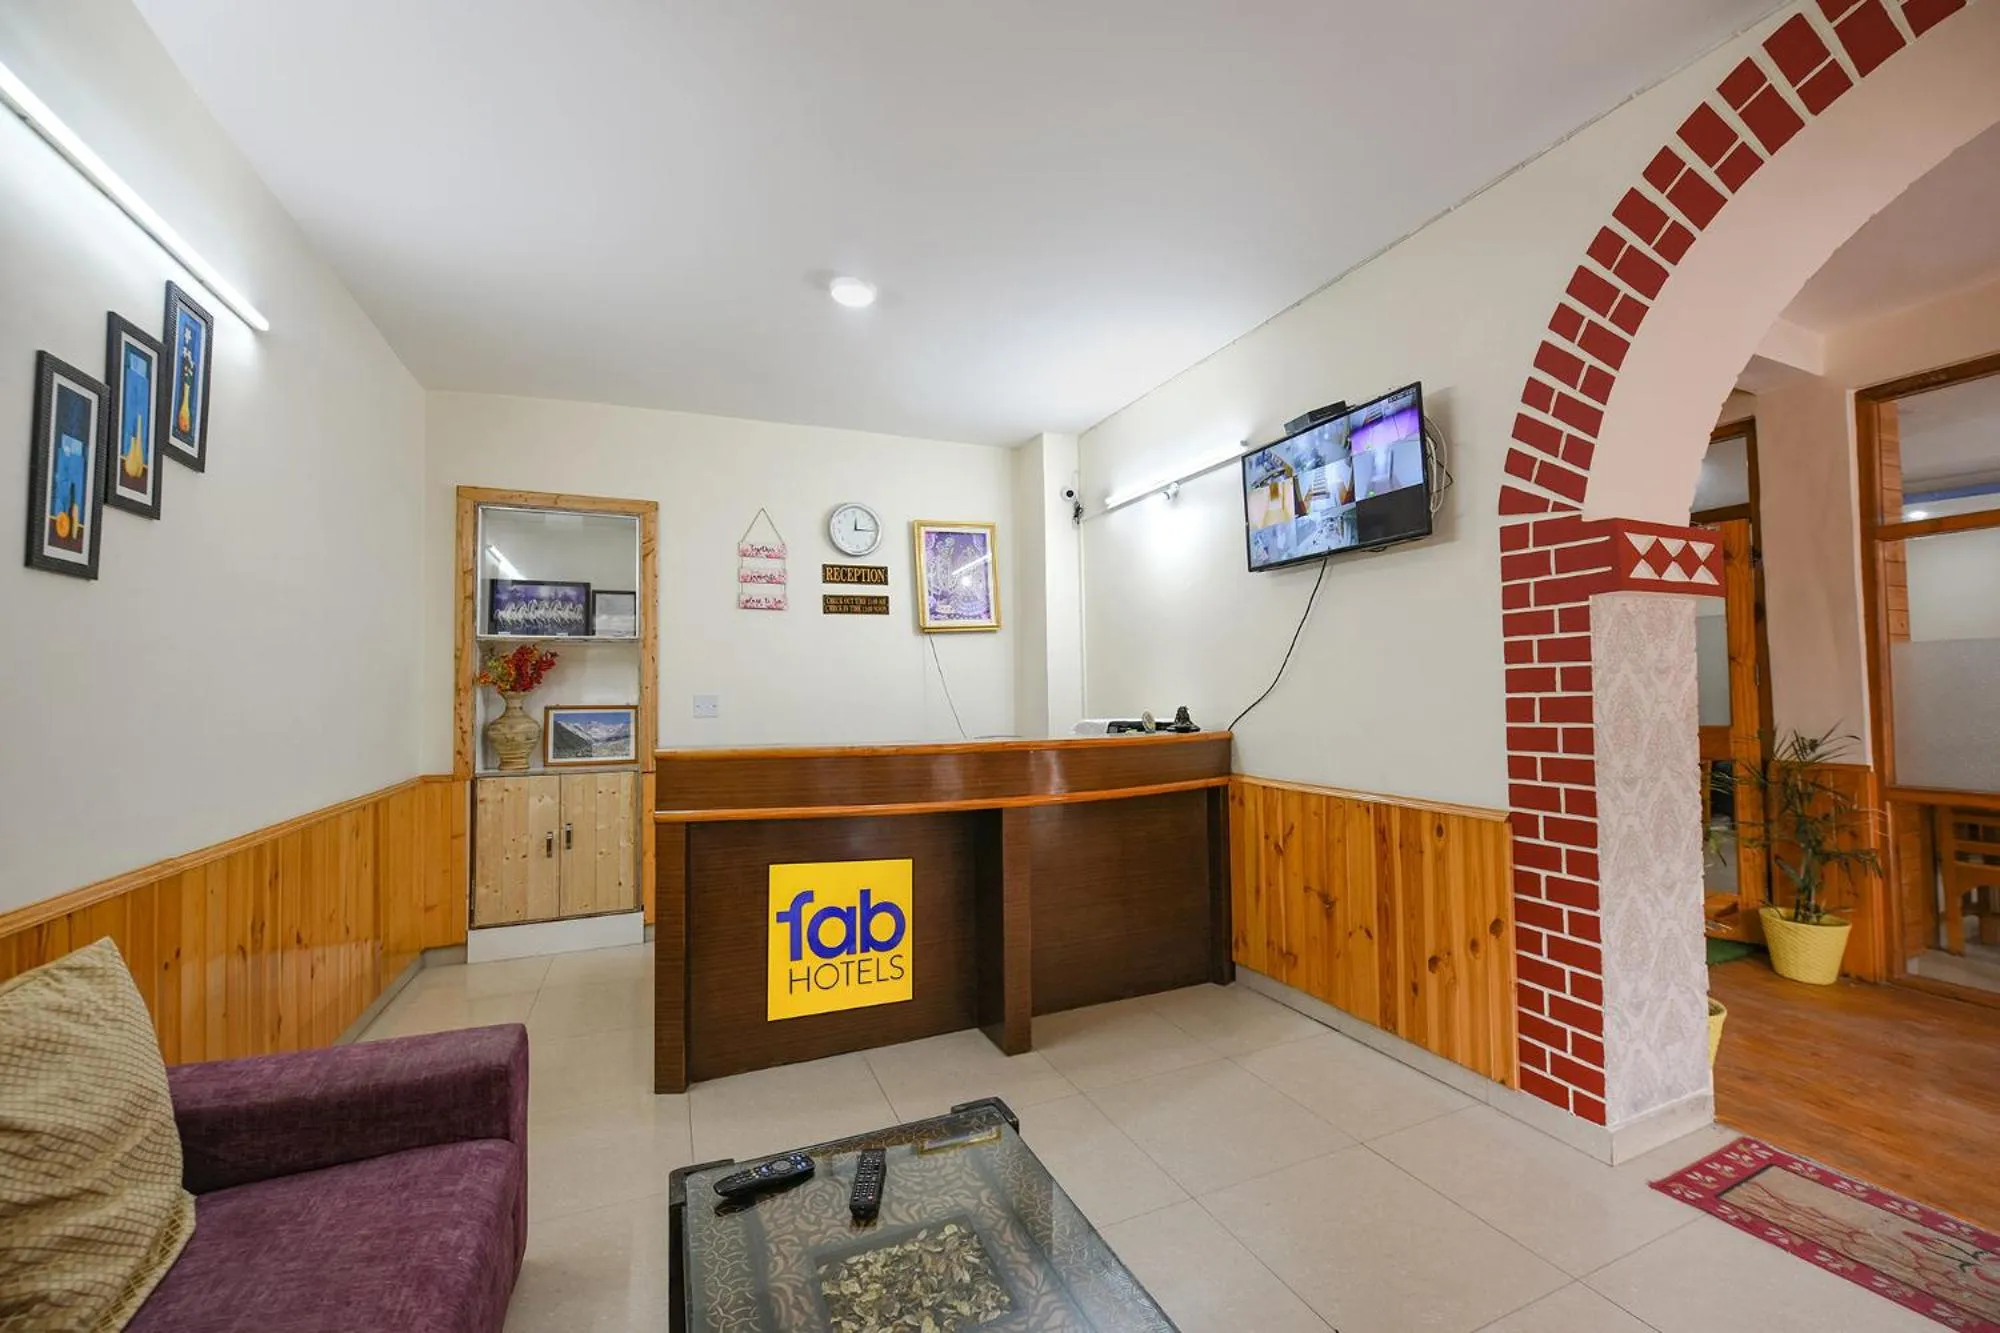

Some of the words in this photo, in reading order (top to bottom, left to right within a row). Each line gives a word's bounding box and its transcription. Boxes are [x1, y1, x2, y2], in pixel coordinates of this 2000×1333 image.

[826, 567, 885, 582] RECEPTION
[776, 889, 906, 961] fab
[789, 955, 905, 995] HOTELS
